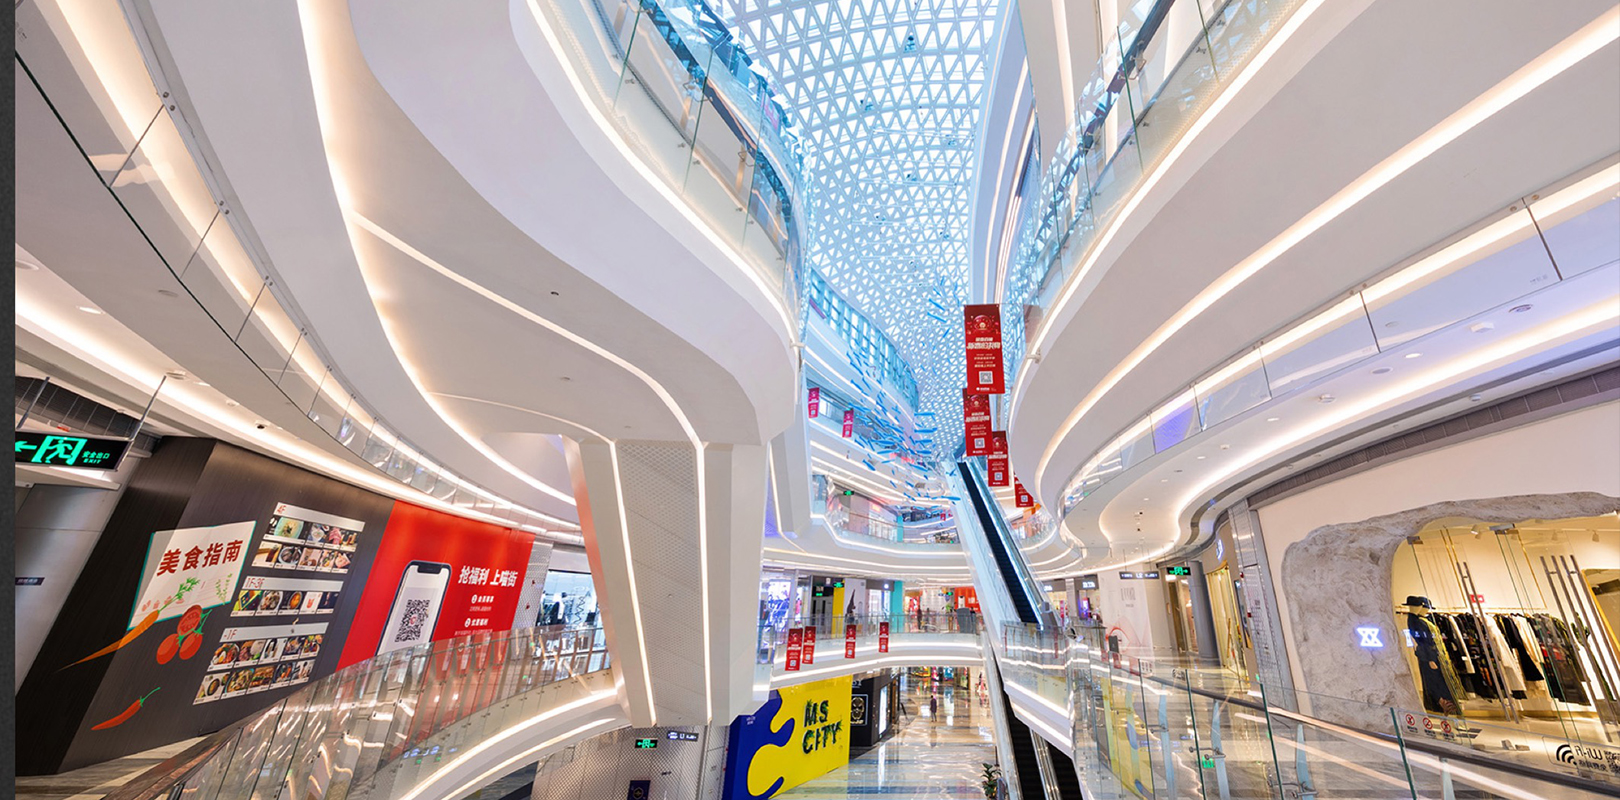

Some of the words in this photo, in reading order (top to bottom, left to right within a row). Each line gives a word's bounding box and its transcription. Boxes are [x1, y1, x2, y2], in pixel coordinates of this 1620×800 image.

[81, 450, 110, 460] 安全出口
[156, 539, 244, 577] 美食指南
[244, 577, 265, 588] 1F-3F
[458, 565, 490, 586] 抢福利
[803, 699, 829, 728] MS
[801, 719, 843, 755] CITY
